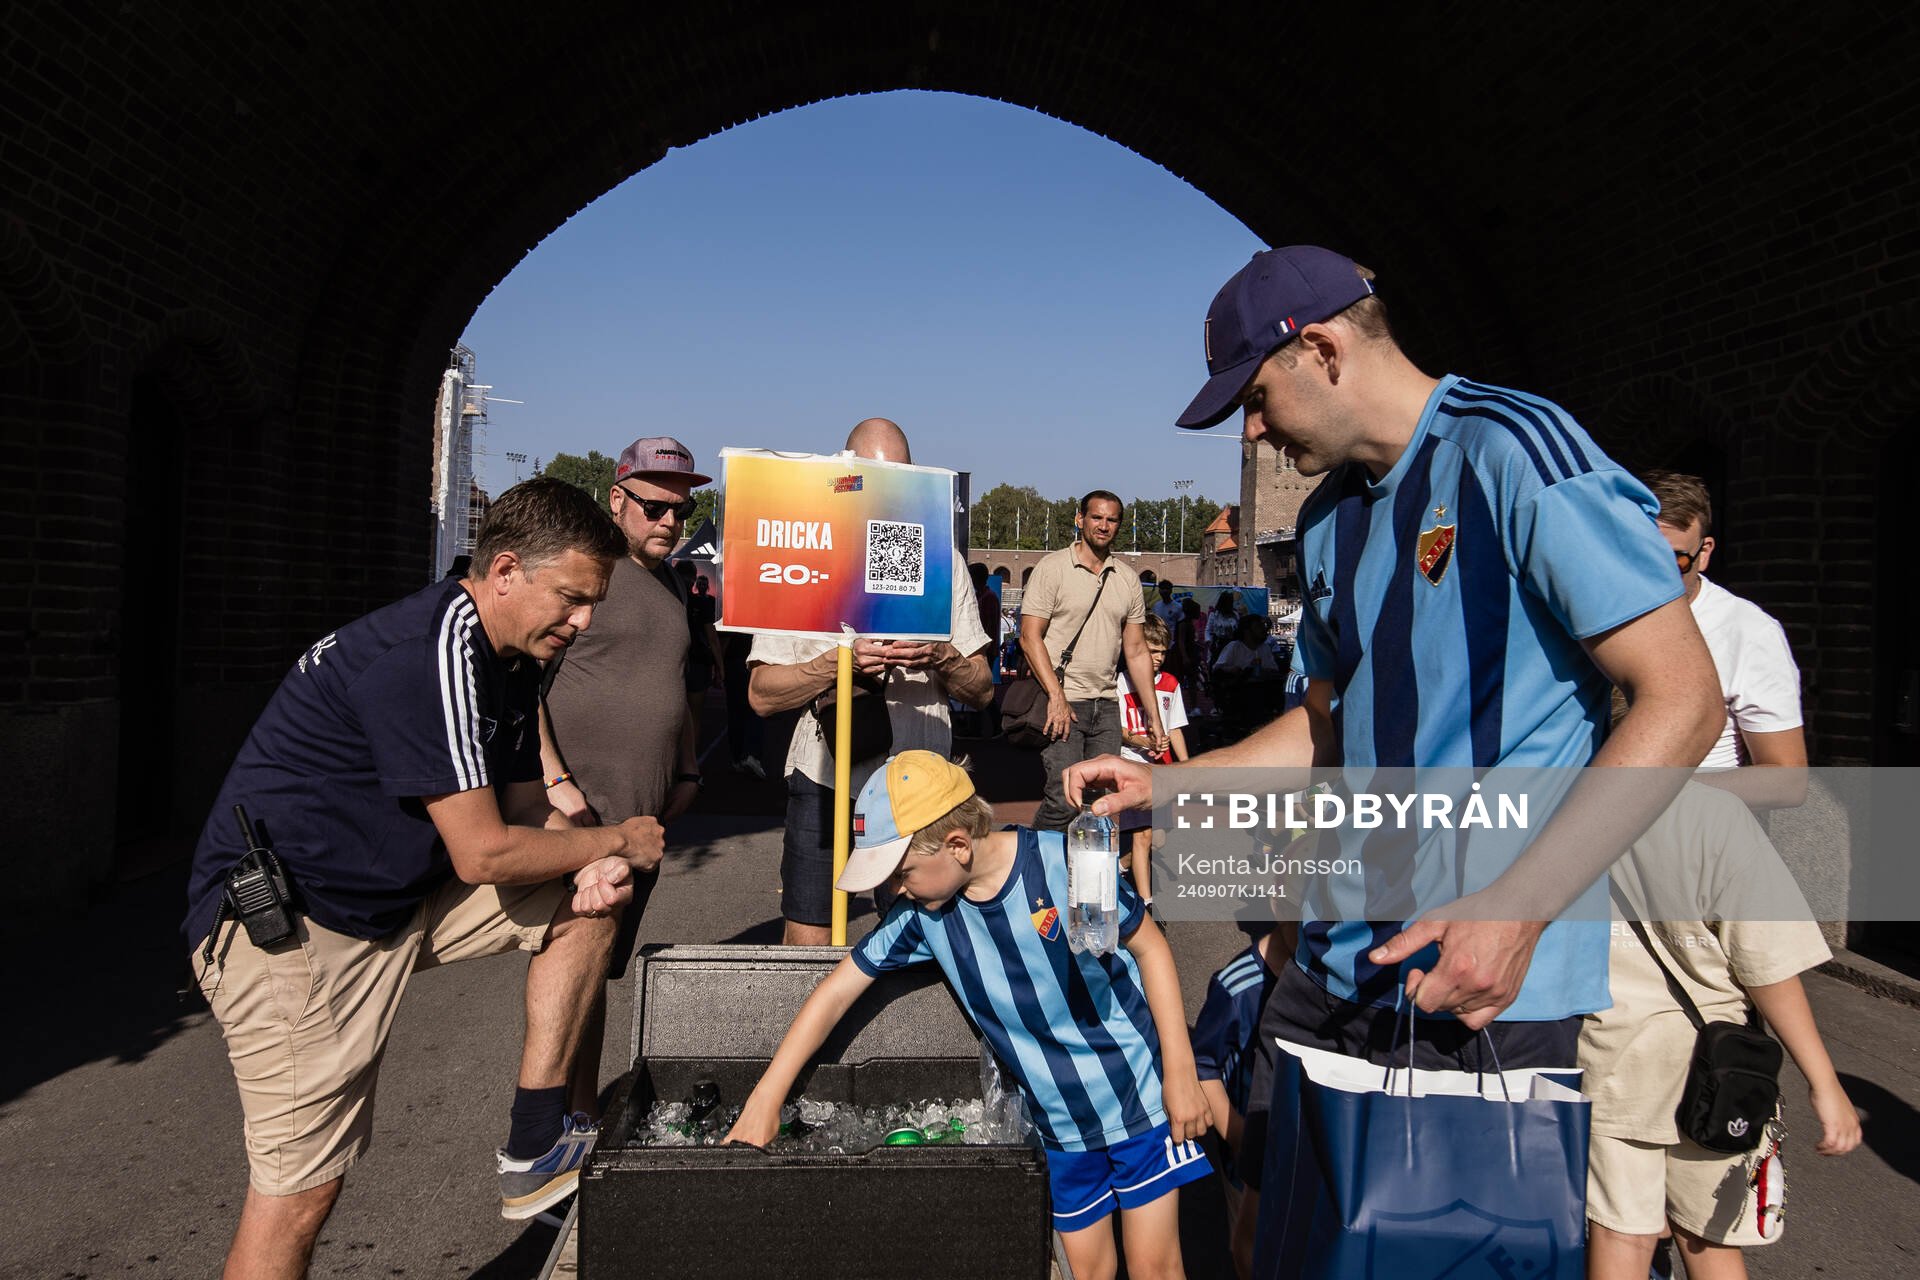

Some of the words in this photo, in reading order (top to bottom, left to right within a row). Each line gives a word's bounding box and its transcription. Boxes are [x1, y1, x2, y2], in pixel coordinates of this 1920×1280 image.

[757, 518, 833, 550] DRICKA
[759, 562, 830, 585] 20:-
[872, 583, 897, 591] 123-201
[909, 585, 917, 593] 75
